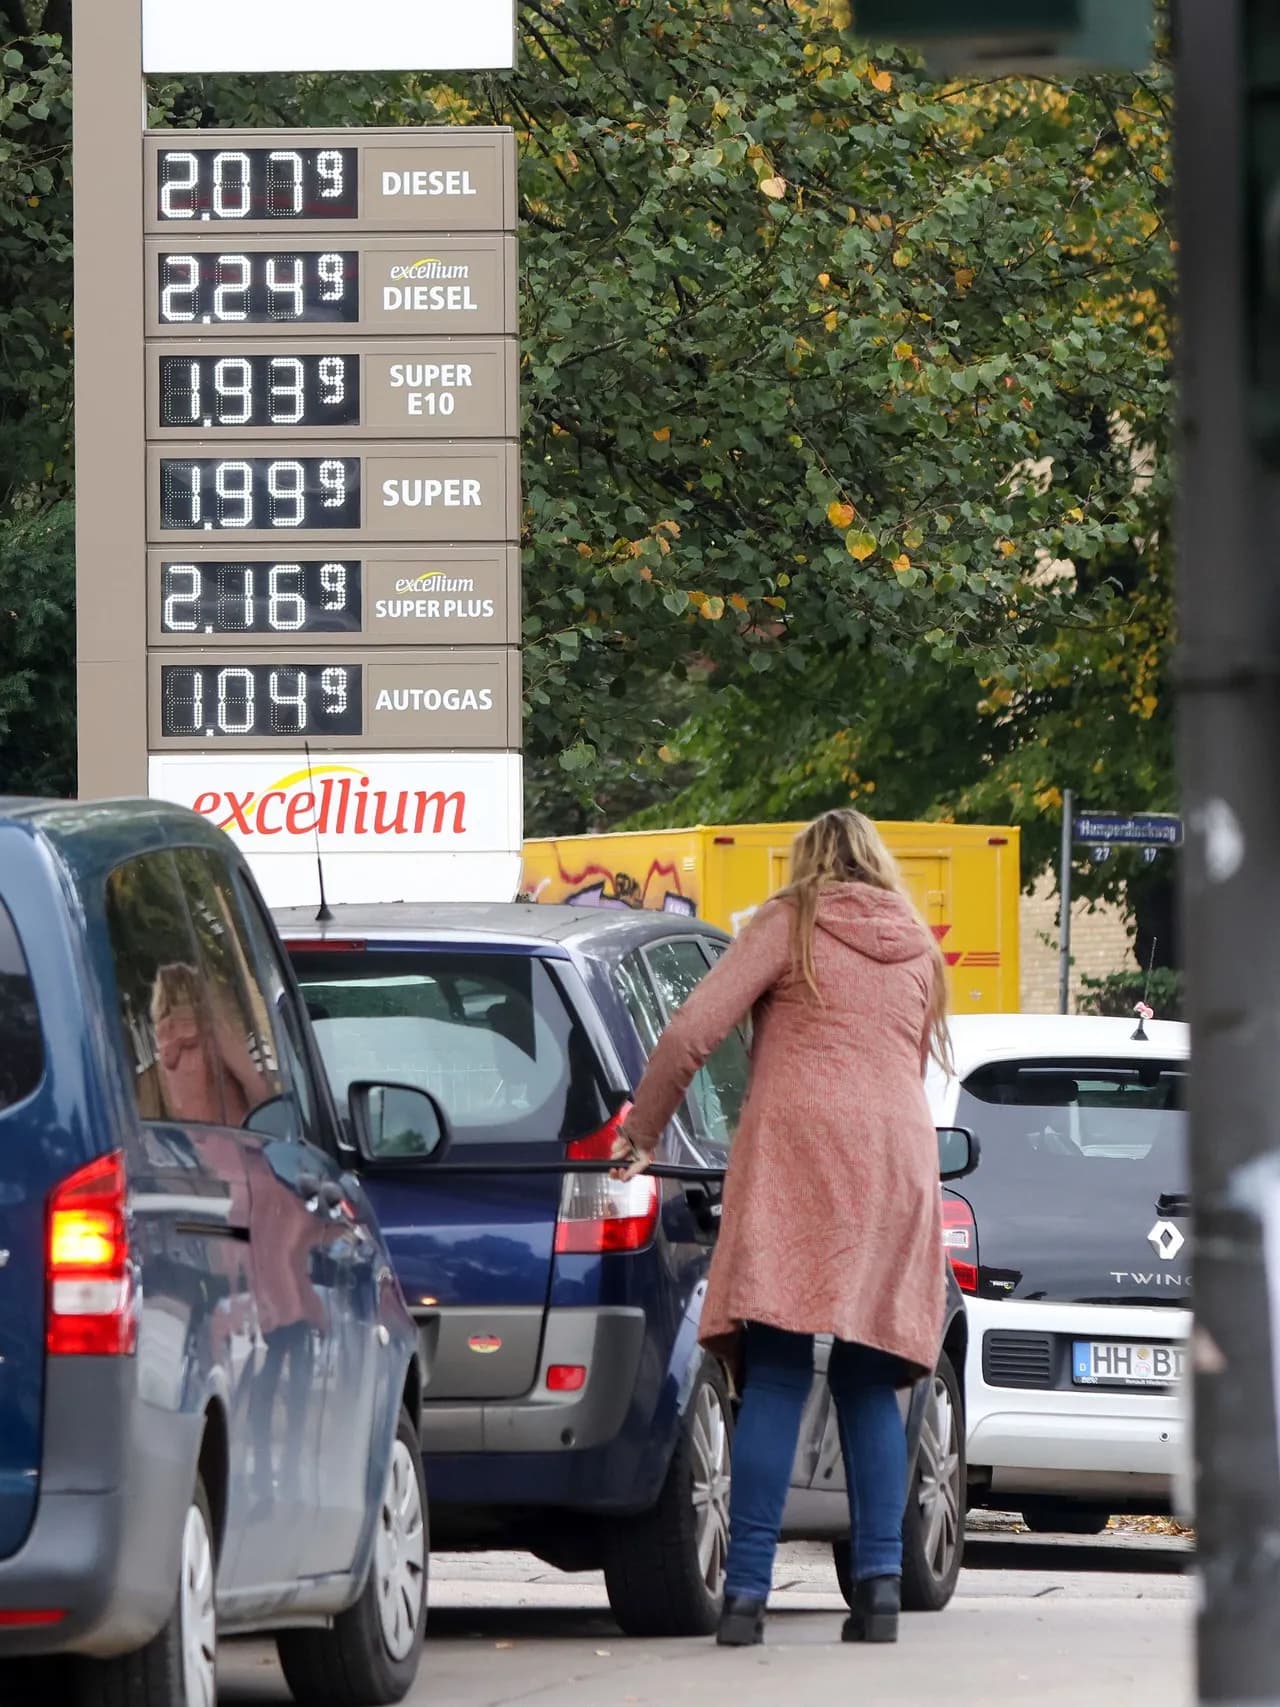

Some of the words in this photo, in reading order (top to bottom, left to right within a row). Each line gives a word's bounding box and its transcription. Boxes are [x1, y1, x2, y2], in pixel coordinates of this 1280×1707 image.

[161, 151, 343, 220] 2.079
[382, 170, 477, 196] DIESEL
[390, 261, 469, 281] excellium
[162, 254, 344, 324] 2.249
[384, 286, 477, 311] DIESEL
[389, 364, 472, 388] SUPER
[190, 357, 345, 427] 1.939
[407, 392, 455, 416] E10
[191, 460, 346, 530] 1.999
[382, 479, 482, 507] SUPER
[395, 573, 475, 593] excellium
[164, 563, 347, 634] 2.169
[375, 600, 440, 619] SUPER
[444, 599, 494, 618] PLUS
[193, 667, 348, 737] 1.049
[375, 688, 493, 711] AUTOGAS
[192, 776, 467, 835] excellium
[1093, 1346, 1132, 1375] HH
